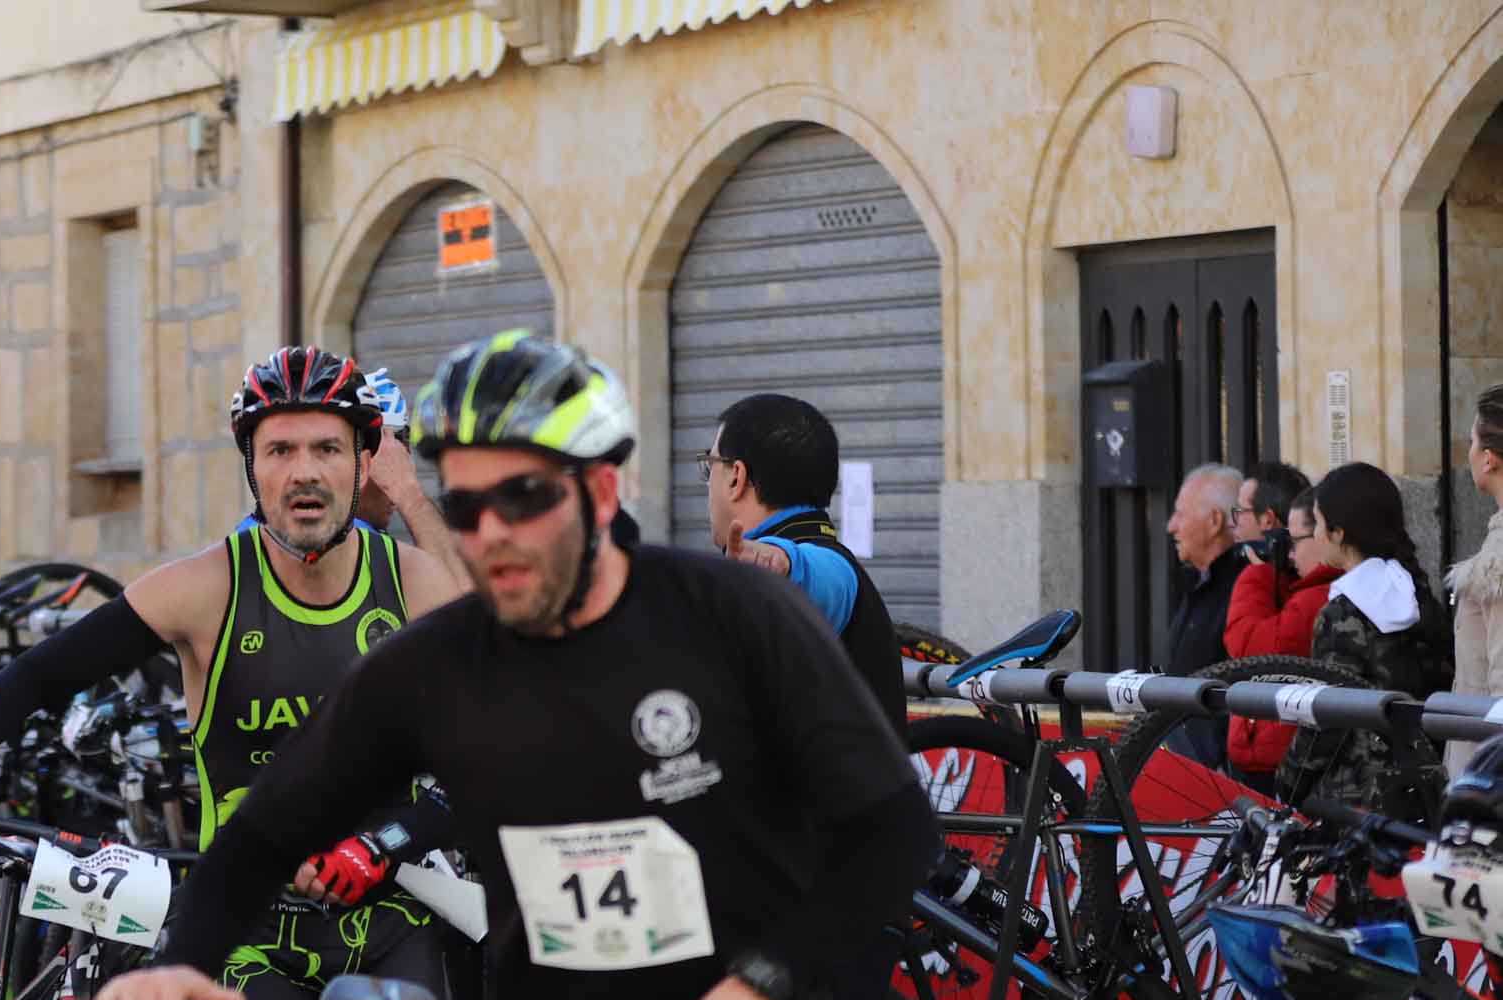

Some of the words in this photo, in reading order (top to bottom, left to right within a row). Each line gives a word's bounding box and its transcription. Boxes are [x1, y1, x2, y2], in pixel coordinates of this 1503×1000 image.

[69, 866, 129, 900] 67
[562, 869, 638, 919] 14
[1432, 873, 1488, 920] 74
